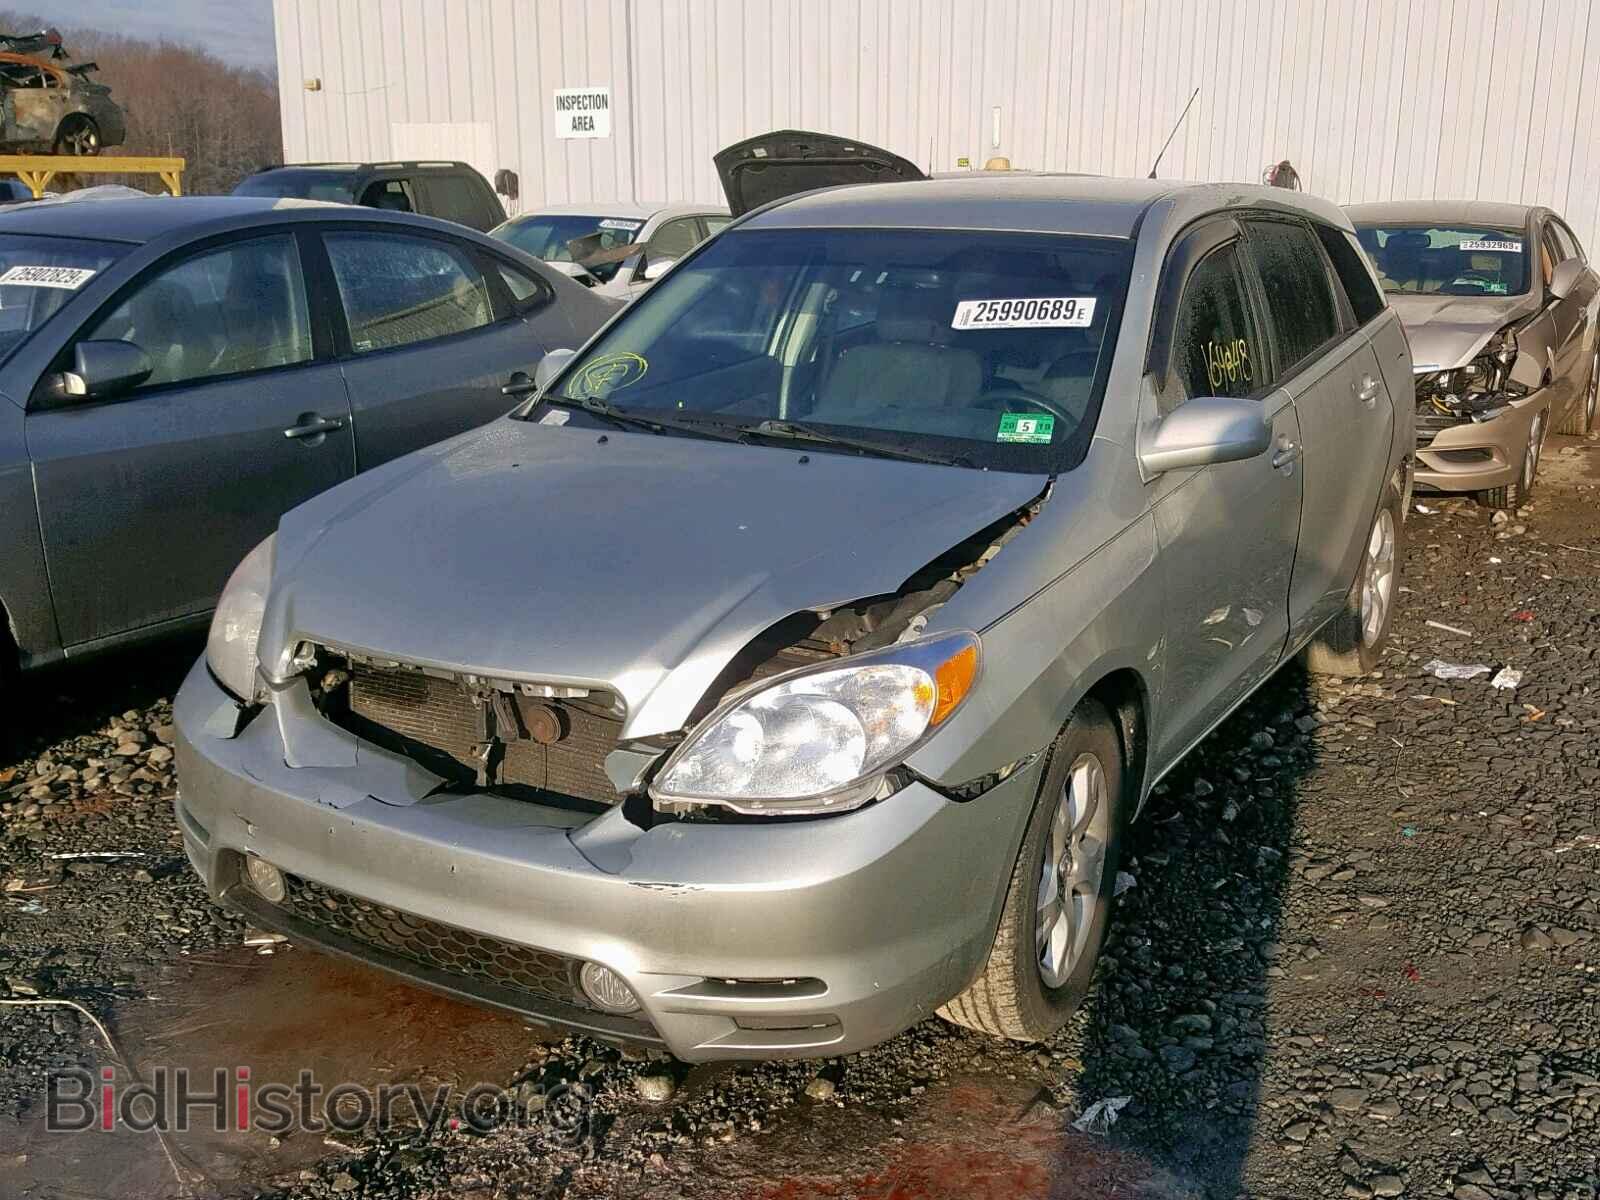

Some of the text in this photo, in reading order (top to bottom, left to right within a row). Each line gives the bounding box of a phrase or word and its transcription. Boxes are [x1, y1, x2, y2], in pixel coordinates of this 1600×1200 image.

[556, 94, 608, 111] INSPECTION
[572, 115, 595, 131] AREA
[1021, 421, 1030, 432] 5
